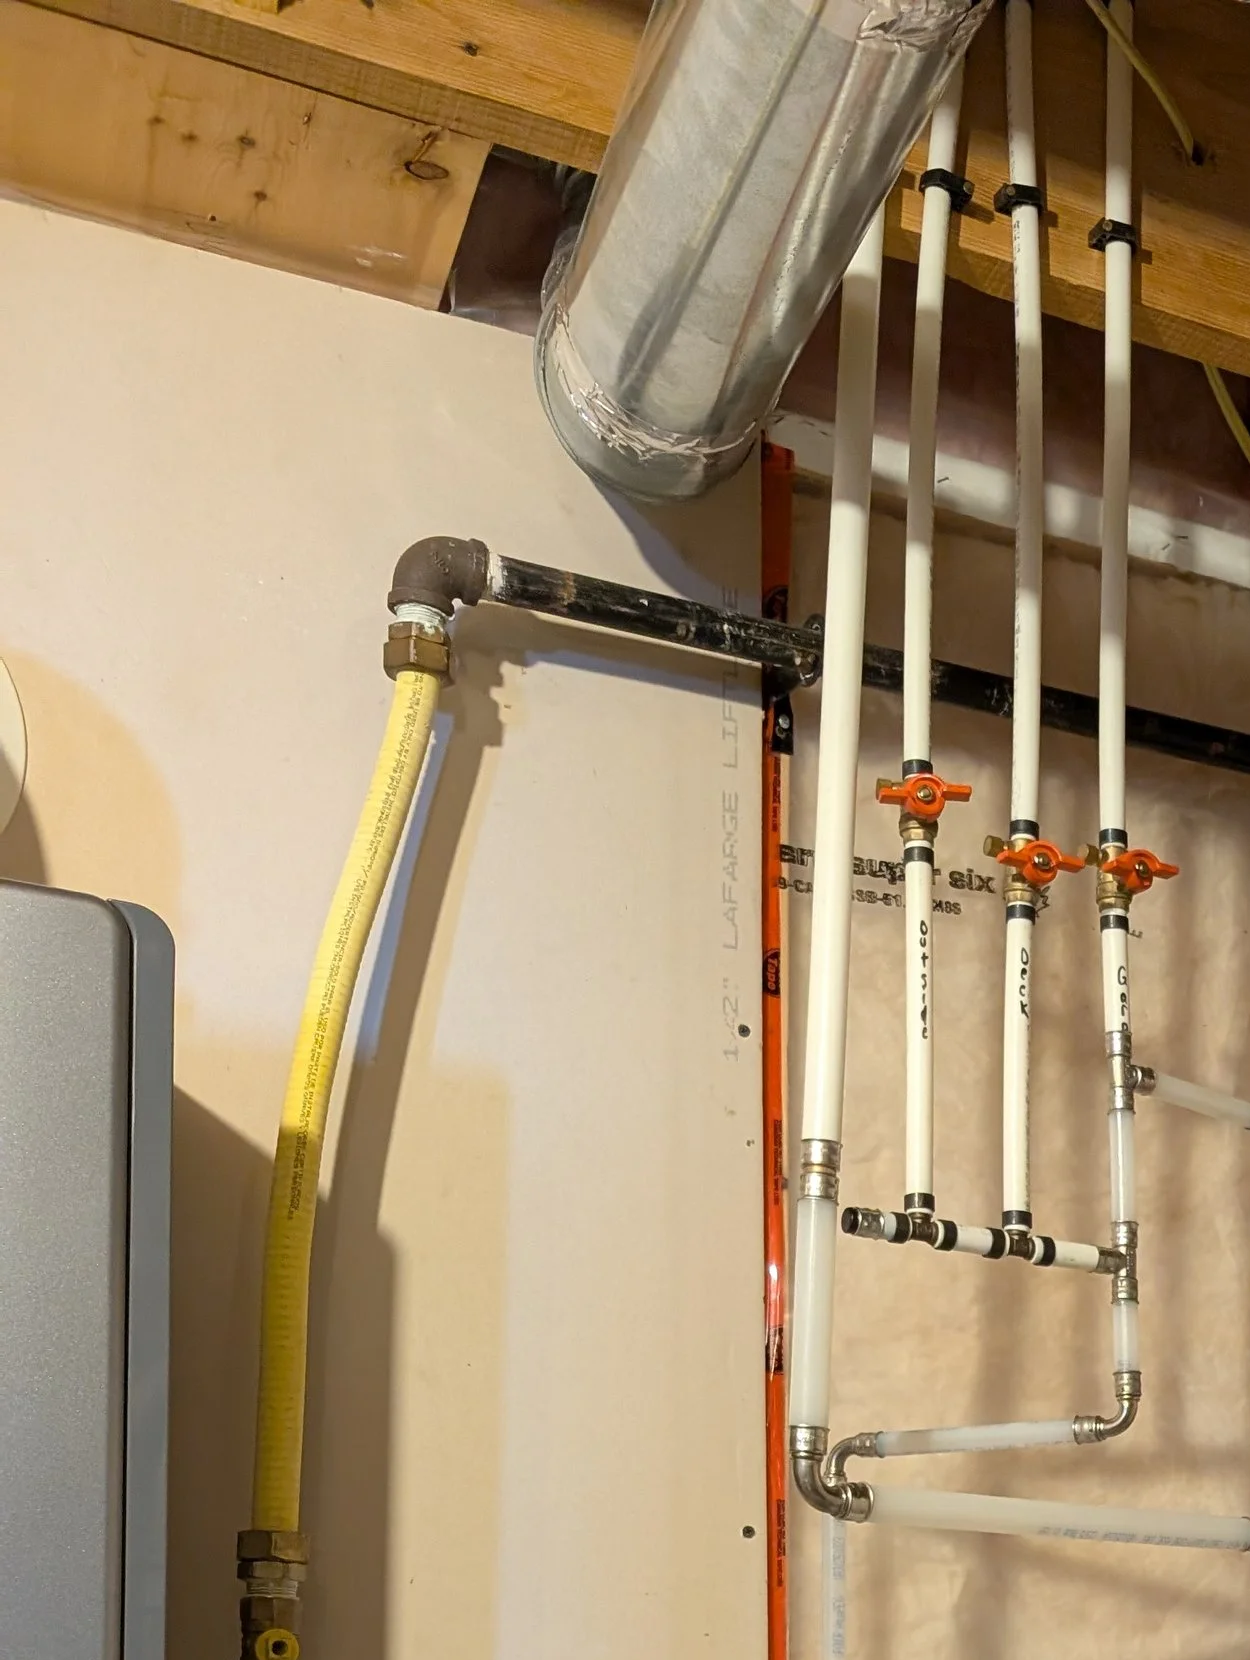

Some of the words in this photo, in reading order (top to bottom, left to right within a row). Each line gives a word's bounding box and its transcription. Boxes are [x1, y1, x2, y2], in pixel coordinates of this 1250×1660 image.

[722, 790, 739, 950] LAFARGE
[949, 868, 996, 894] six
[767, 955, 779, 992] Tape
[1018, 947, 1030, 1018] Deck
